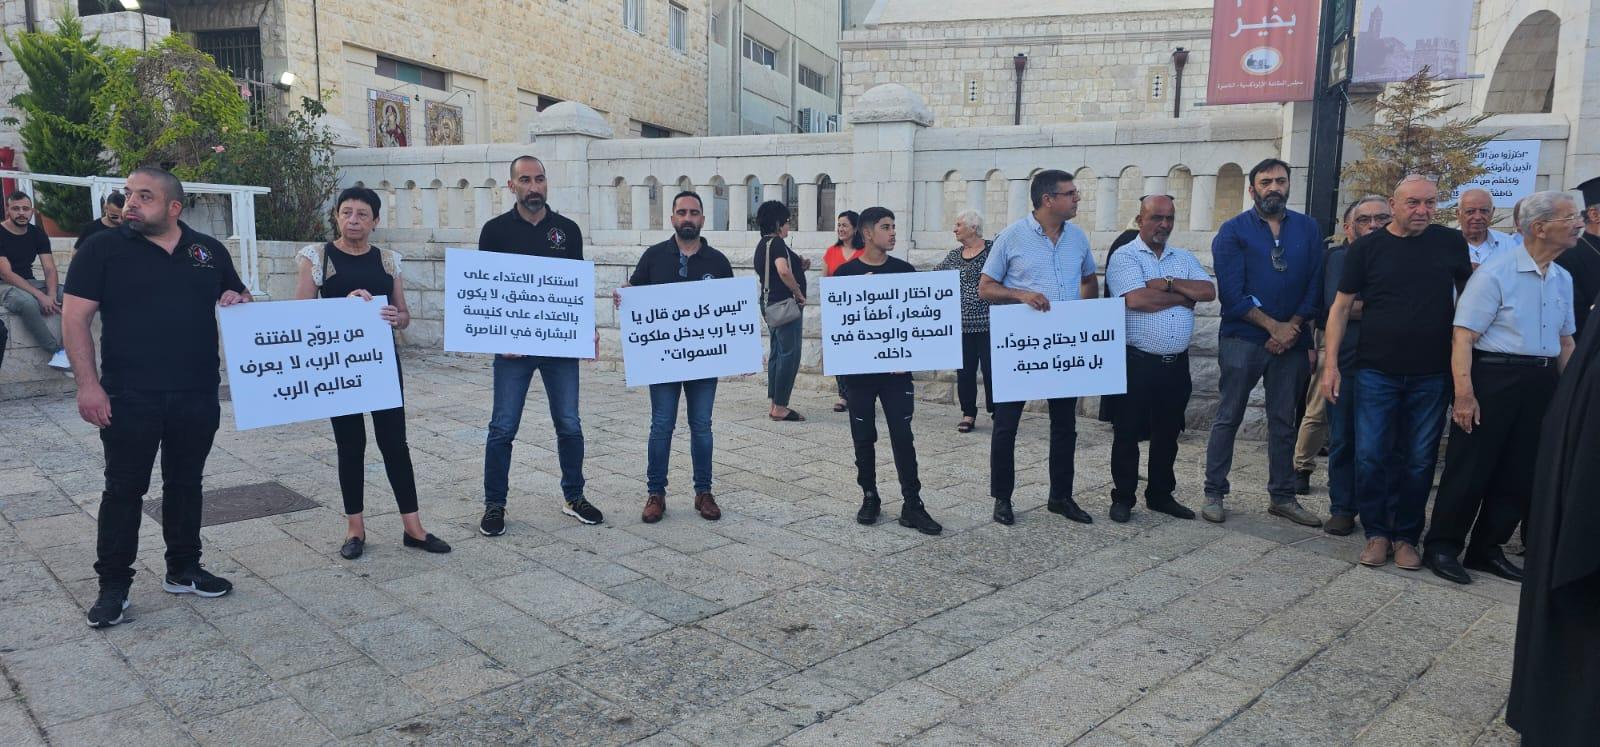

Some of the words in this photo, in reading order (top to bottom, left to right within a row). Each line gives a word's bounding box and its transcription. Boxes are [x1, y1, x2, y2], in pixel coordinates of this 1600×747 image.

[1229, 6, 1297, 38] بخير
[464, 269, 489, 281] على
[493, 272, 534, 283] الاعتداء
[538, 276, 578, 287] استنكار
[458, 288, 487, 301] يكون
[490, 289, 498, 299] لا
[502, 290, 544, 303] دمشق،
[548, 294, 584, 307] كنيسة
[828, 291, 852, 306] راية
[856, 289, 899, 304] السواد
[903, 287, 931, 302] اختار
[935, 288, 953, 300] من
[464, 305, 502, 319] كنيسة
[506, 309, 531, 319] على
[646, 308, 668, 323] قال
[672, 308, 690, 321] من
[694, 304, 710, 319] كل
[714, 300, 747, 317] "ليس
[864, 305, 892, 321] أطفأ
[897, 305, 941, 322] وشعار،
[534, 310, 579, 325] بالاعتداء
[632, 311, 642, 325] يا
[842, 310, 860, 325] نور
[307, 325, 339, 347] يروّج
[344, 327, 364, 342] من
[466, 324, 507, 337] الناصرة
[511, 327, 532, 339] في
[535, 329, 577, 341] البشارة
[674, 327, 704, 342] يدخل
[708, 326, 723, 338] رب
[726, 322, 736, 336] يا
[739, 322, 754, 335] رب
[858, 328, 908, 342] والوحدة
[912, 325, 952, 340] المحبة
[1092, 329, 1115, 342] الله
[255, 329, 302, 346] للفتنة
[628, 330, 670, 346] ملكوت
[831, 330, 853, 345] في
[997, 333, 1040, 351] جنودًا..
[1043, 333, 1076, 350] يحتاج
[1080, 331, 1087, 342] لا
[345, 349, 383, 368] باسم
[661, 344, 727, 362] السموات".
[874, 347, 912, 360] داخله.
[240, 360, 282, 377] يعرف
[290, 355, 300, 369] لا
[306, 352, 339, 370] الرب،
[1013, 360, 1049, 374] محبة.
[1053, 355, 1085, 371] قلوبًا
[1089, 355, 1102, 369] بل
[273, 381, 308, 400] الرب.
[314, 374, 362, 397] تعاليم
